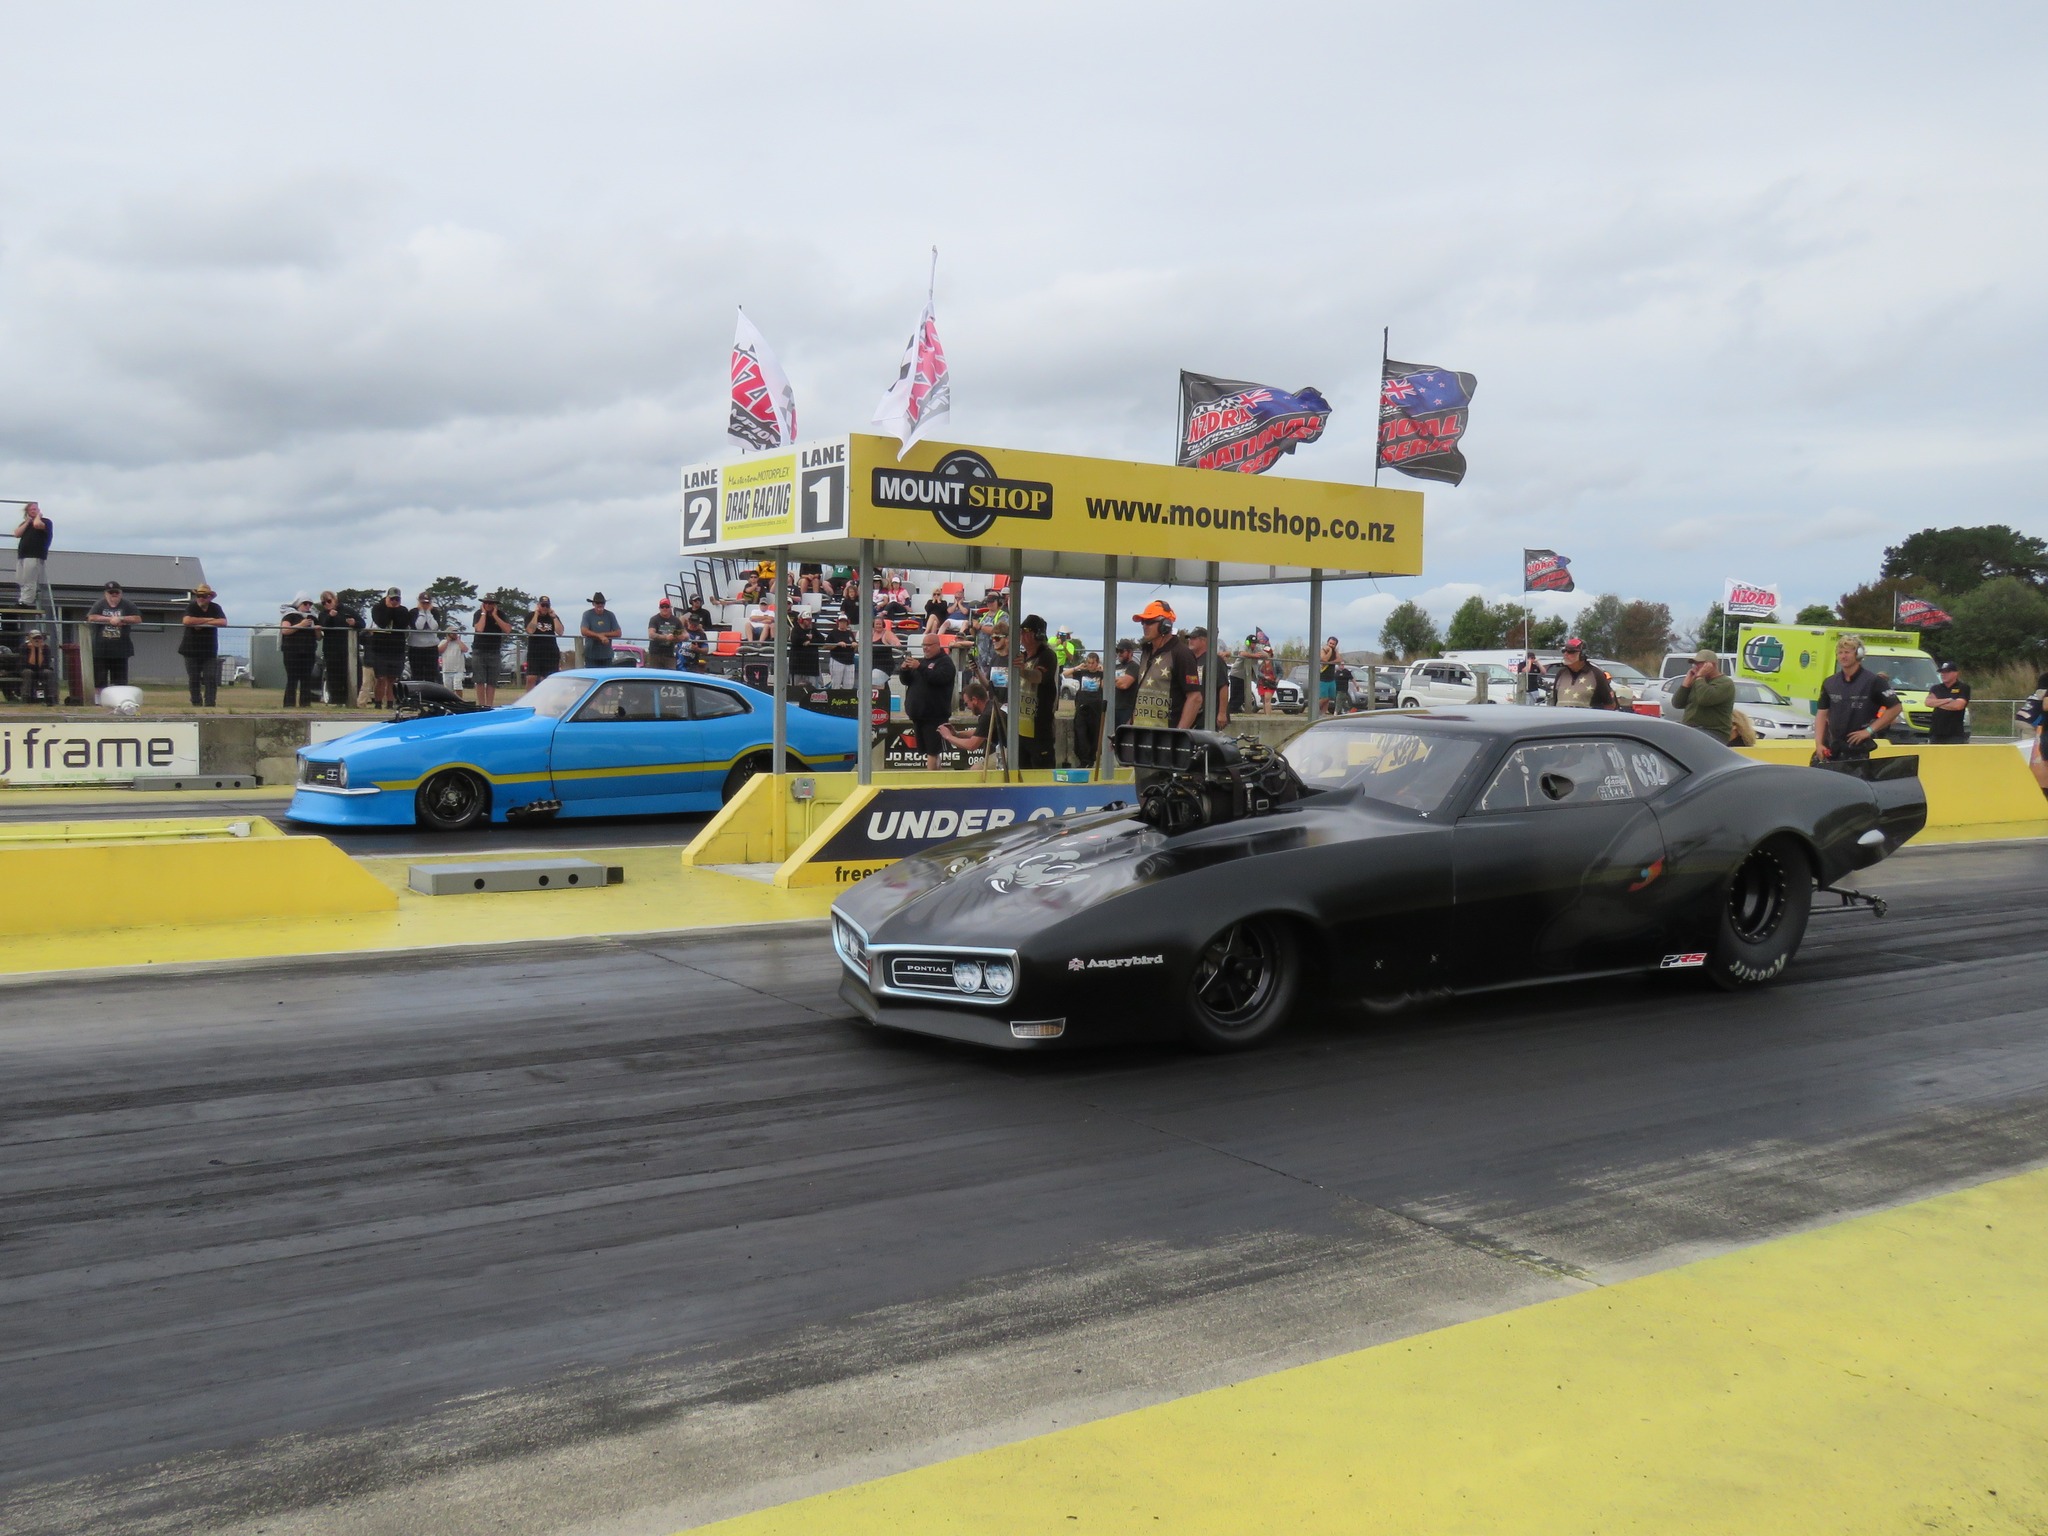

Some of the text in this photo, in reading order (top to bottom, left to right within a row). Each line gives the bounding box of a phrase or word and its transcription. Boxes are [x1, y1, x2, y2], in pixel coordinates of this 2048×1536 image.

[1187, 408, 1254, 444] NZDRA
[802, 444, 845, 468] LANE
[684, 469, 718, 489] LANE
[725, 483, 791, 522] DRAG RACING
[809, 476, 831, 523] 1
[879, 476, 1048, 512] MOUNT SHOP
[688, 496, 712, 539] 2
[1086, 496, 1396, 543] www.mountshop.co.nz
[1731, 589, 1777, 606] NZDRA
[660, 686, 685, 697] 628
[1137, 695, 1173, 707] ERTON
[1134, 708, 1173, 719] ORPLEX
[0, 727, 174, 776] jframe
[885, 752, 902, 761] JD
[1631, 753, 1668, 787] 632
[867, 808, 1015, 841] UNDER
[907, 965, 948, 973] PONTIAC
[1087, 955, 1164, 970] Angrybird
